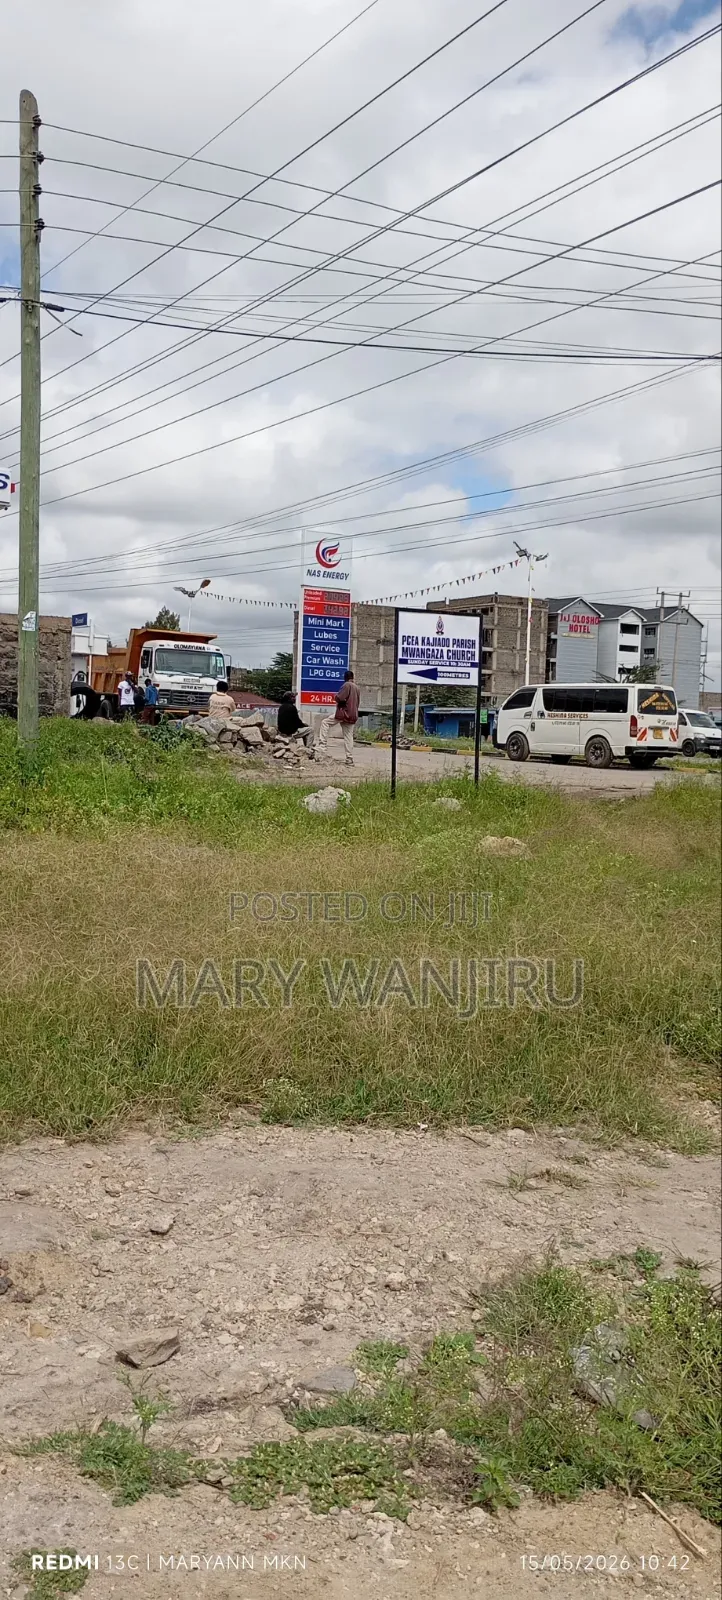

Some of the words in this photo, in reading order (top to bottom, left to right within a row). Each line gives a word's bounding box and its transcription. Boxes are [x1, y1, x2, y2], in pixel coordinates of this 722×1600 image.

[306, 569, 321, 578] NAS
[322, 571, 349, 580] ENERGY
[308, 617, 325, 626] Mini
[325, 619, 344, 628] Mart
[572, 615, 601, 625] OLOSHO
[568, 624, 591, 634] HOTEL
[314, 630, 338, 640] Lubes
[401, 635, 419, 646] PCEA
[421, 636, 450, 647] KAJIADO
[452, 638, 476, 649] PARISH
[310, 643, 340, 653] Service
[401, 647, 444, 659] MWANGAZA
[446, 649, 476, 661] CHURCH
[306, 655, 321, 664] Car
[322, 656, 345, 666] Wash
[309, 668, 324, 677] LPG
[325, 670, 340, 678] Gas
[310, 694, 320, 702] 24
[321, 695, 337, 703] HR
